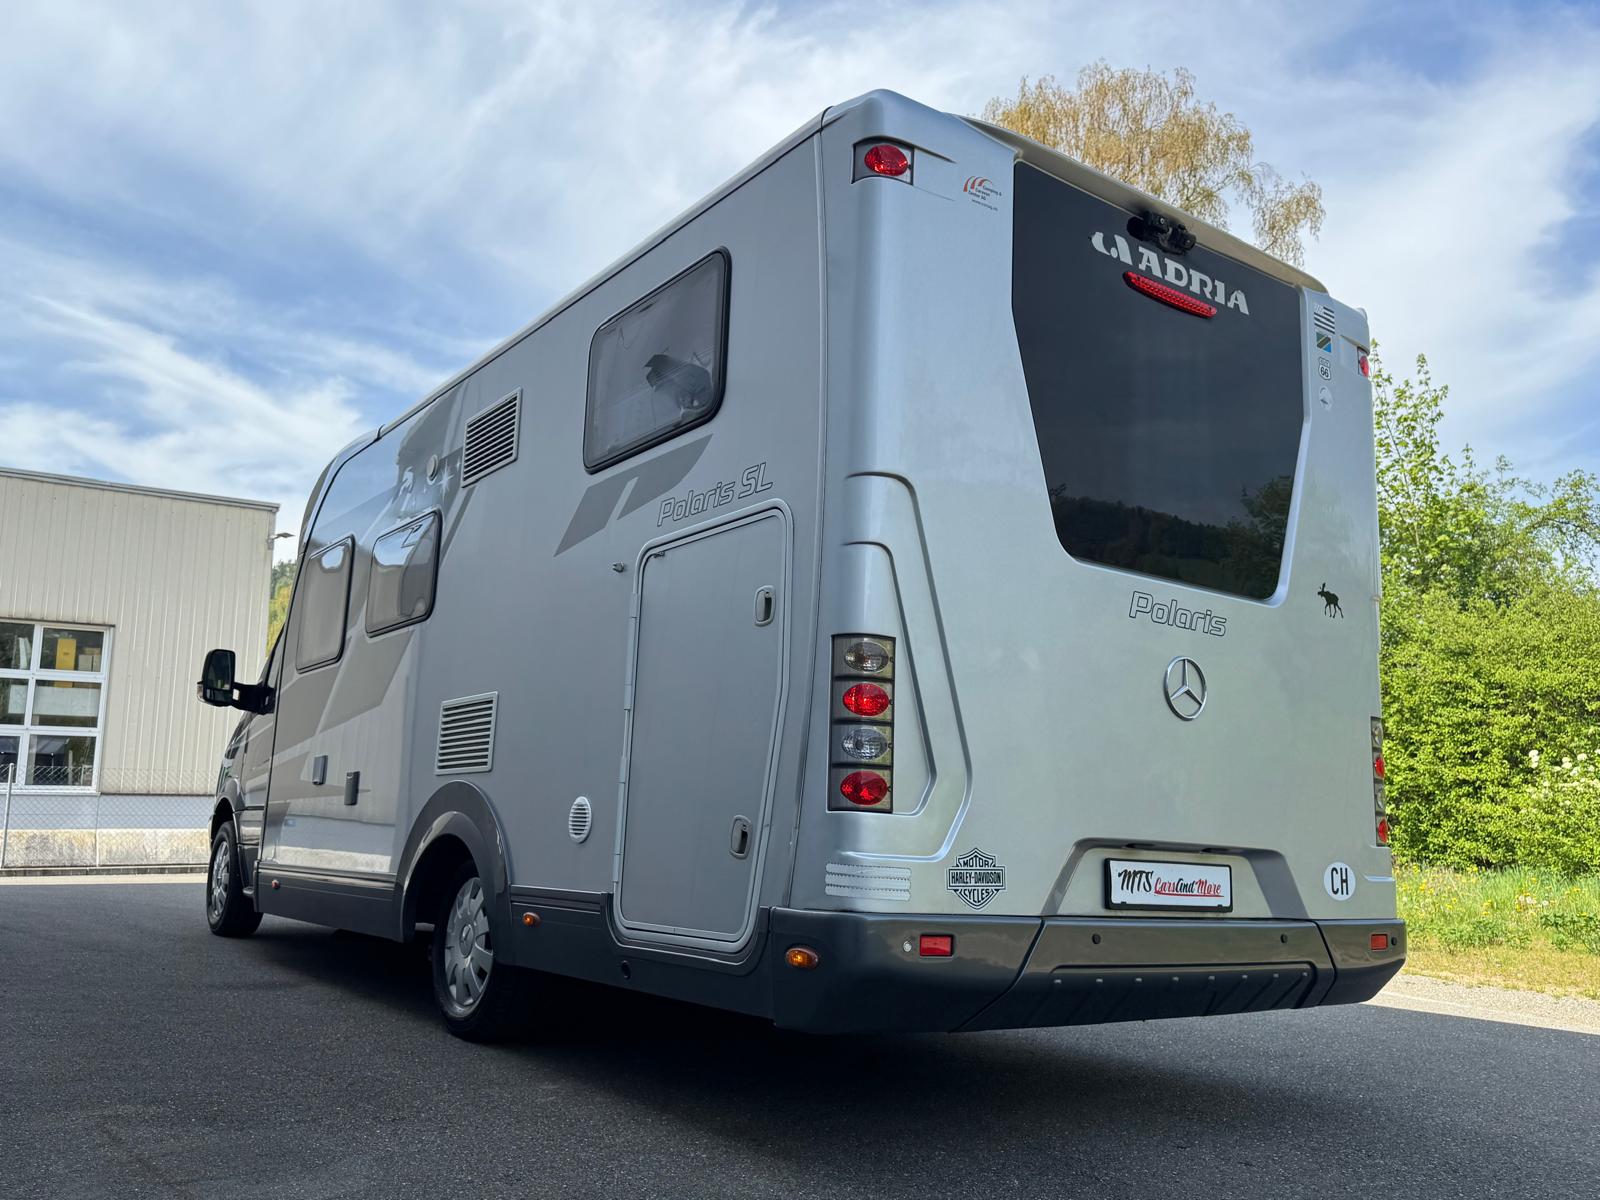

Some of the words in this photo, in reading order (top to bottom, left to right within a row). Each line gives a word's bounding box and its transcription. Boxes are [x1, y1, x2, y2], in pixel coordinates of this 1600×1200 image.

[1138, 245, 1250, 315] ADRIA
[1320, 366, 1330, 378] 66
[656, 481, 736, 528] Polaris
[737, 461, 774, 500] SL
[1128, 590, 1228, 637] Polaris
[962, 855, 990, 868] MOTOR
[951, 871, 1002, 885] HARLEY-DAVIDSON
[1117, 868, 1155, 894] MTS
[1330, 866, 1350, 896] CH
[963, 888, 990, 904] CYCLES
